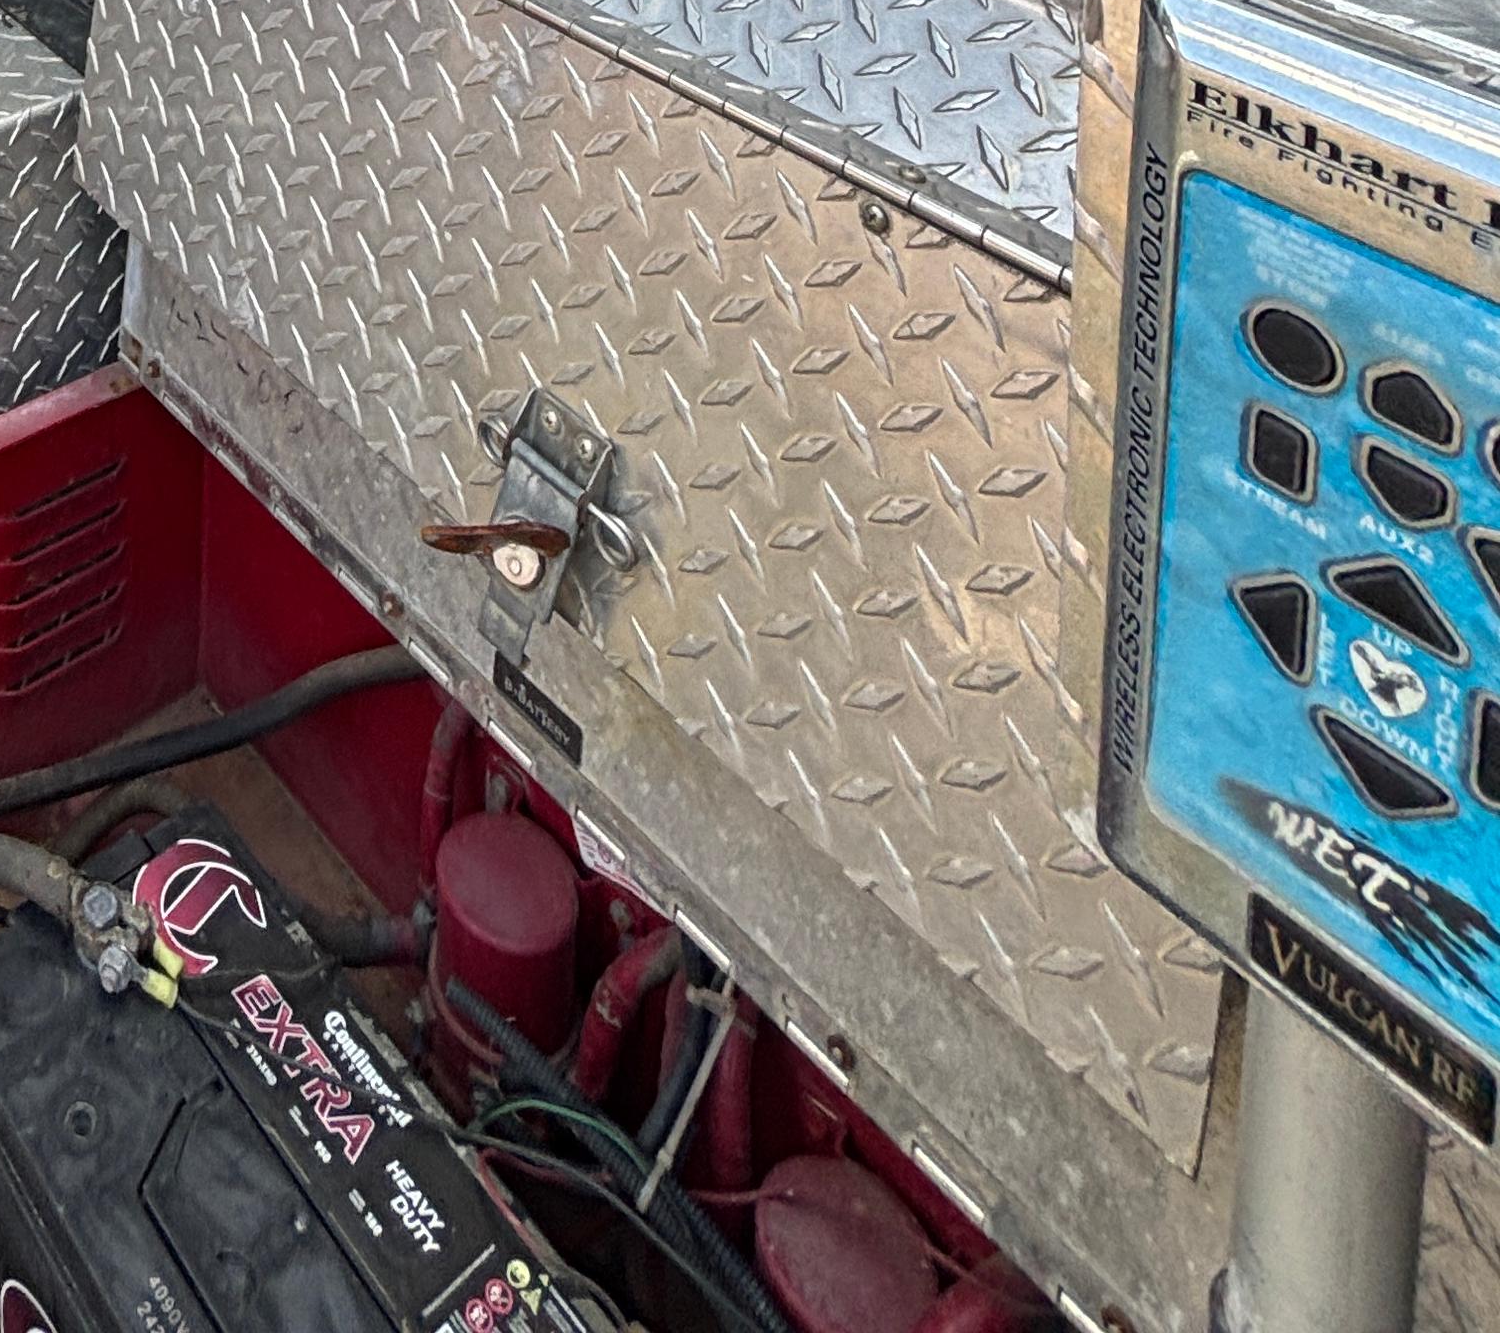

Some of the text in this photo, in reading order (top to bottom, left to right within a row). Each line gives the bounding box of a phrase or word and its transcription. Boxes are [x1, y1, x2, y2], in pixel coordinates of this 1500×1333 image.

[1186, 109, 1255, 149] Fire
[1277, 147, 1444, 232] Fighting
[1188, 78, 1457, 211] Elkhart
[1112, 140, 1168, 775] WIRELESS ELECTRONIC TECHNOLOGY
[1359, 513, 1435, 565] AUX2
[1372, 622, 1413, 656] UP
[1338, 695, 1430, 765] DOWN
[1435, 675, 1460, 771] RIGHT
[1265, 919, 1478, 1104] VULCAN RF
[230, 973, 376, 1166] EXTRA
[385, 1159, 446, 1231] HEAVY
[389, 1194, 442, 1254] DUTY
